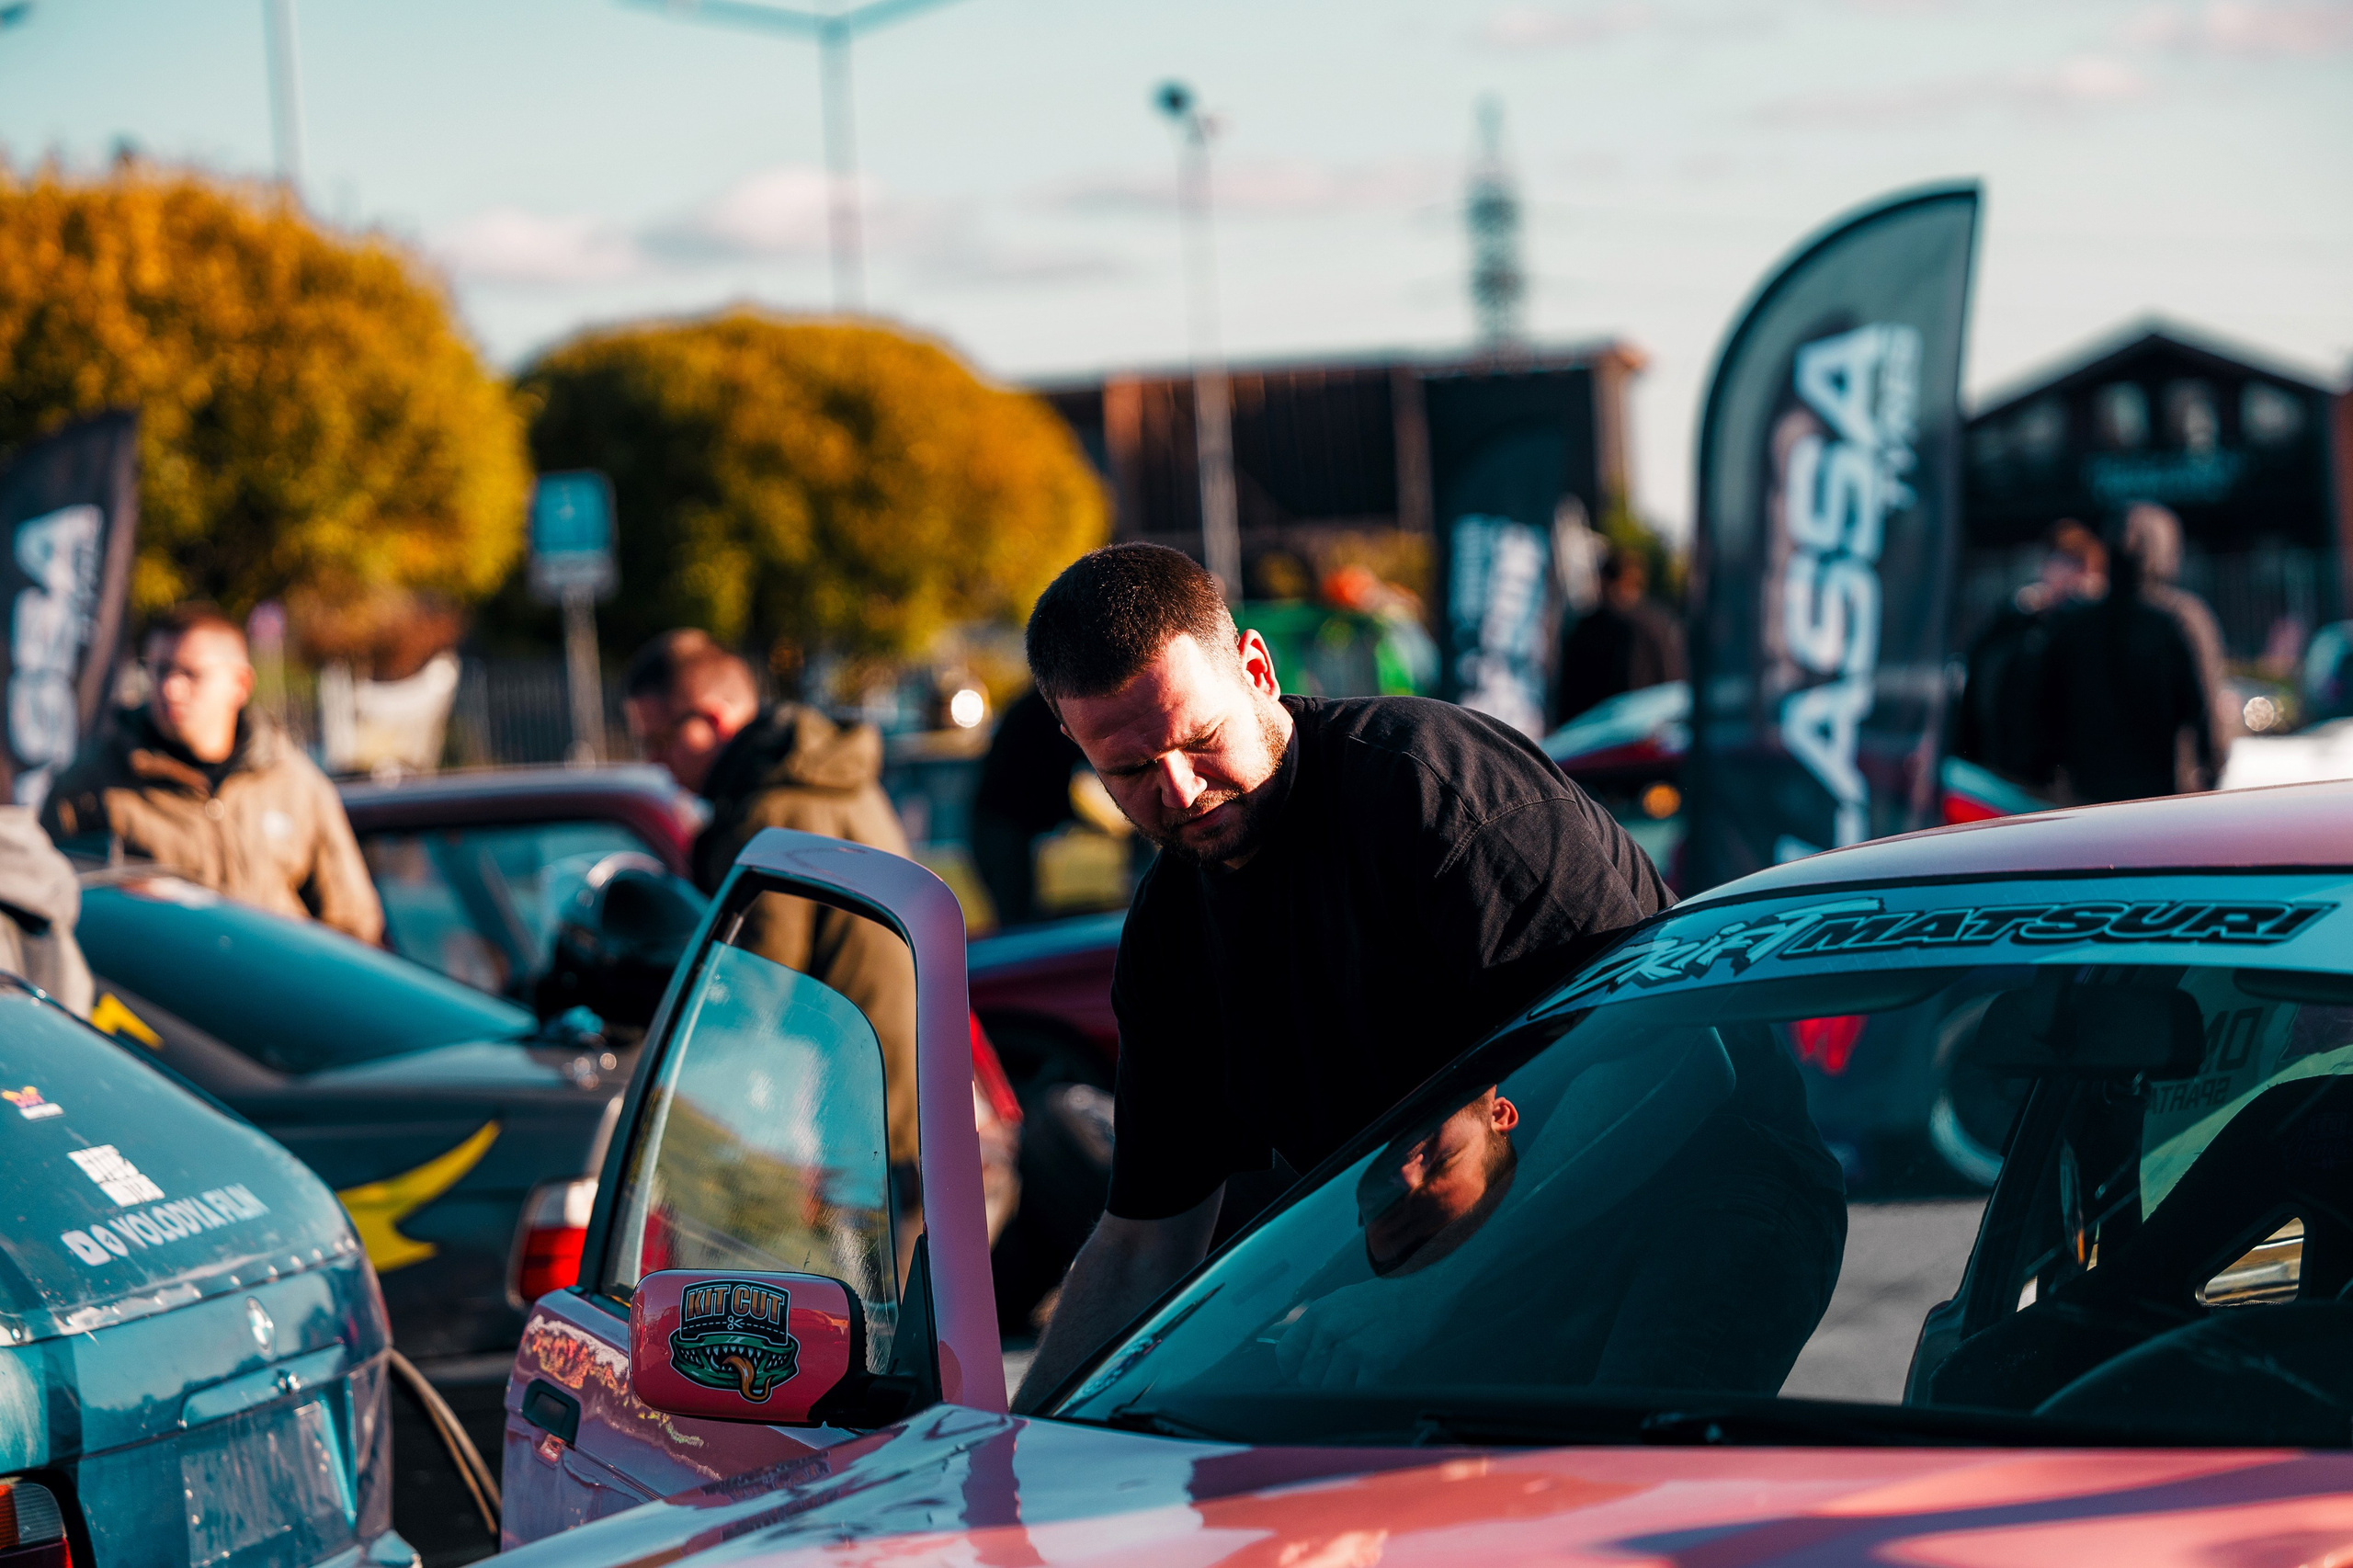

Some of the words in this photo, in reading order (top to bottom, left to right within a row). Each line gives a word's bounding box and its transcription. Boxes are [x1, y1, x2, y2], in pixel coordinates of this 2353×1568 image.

[1778, 902, 2340, 960] MATSURI
[108, 1196, 228, 1250] VOLODYA
[686, 1285, 731, 1322] KIT
[732, 1284, 785, 1324] CUT
